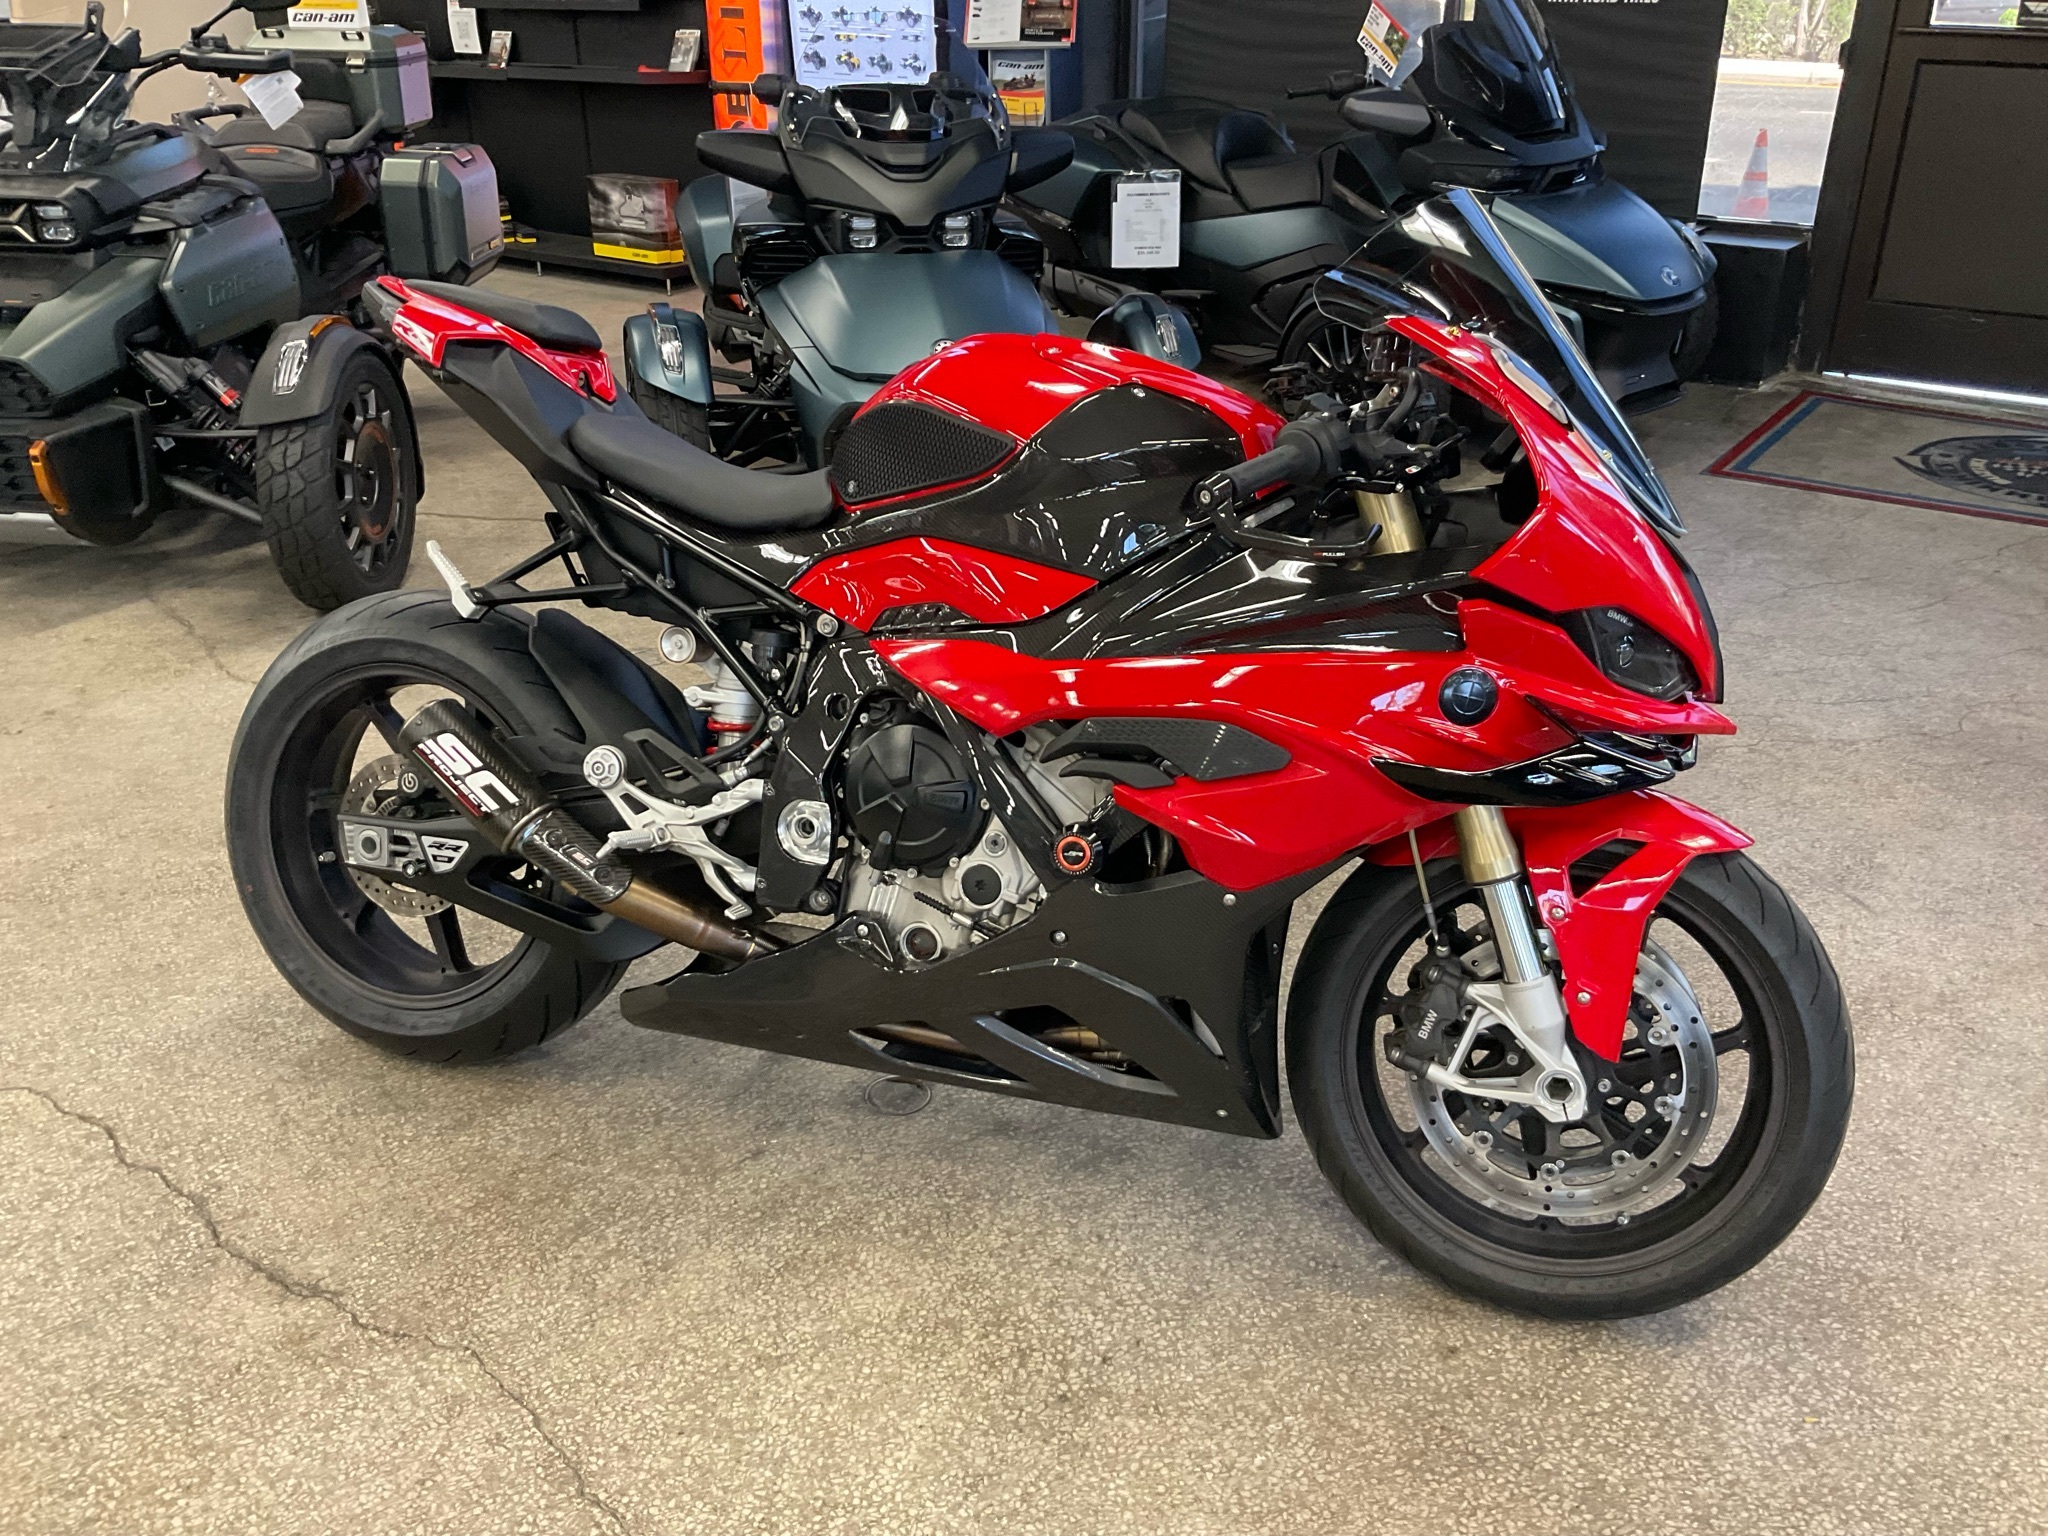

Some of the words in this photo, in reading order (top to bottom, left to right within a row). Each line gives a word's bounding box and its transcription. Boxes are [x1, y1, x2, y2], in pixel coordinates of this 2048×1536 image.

[292, 12, 355, 23] can-am
[997, 61, 1045, 70] can-am
[1360, 35, 1394, 73] can-am
[1607, 609, 1629, 624] BMW
[417, 743, 492, 813] PROJECT
[1417, 1009, 1438, 1040] BMW
